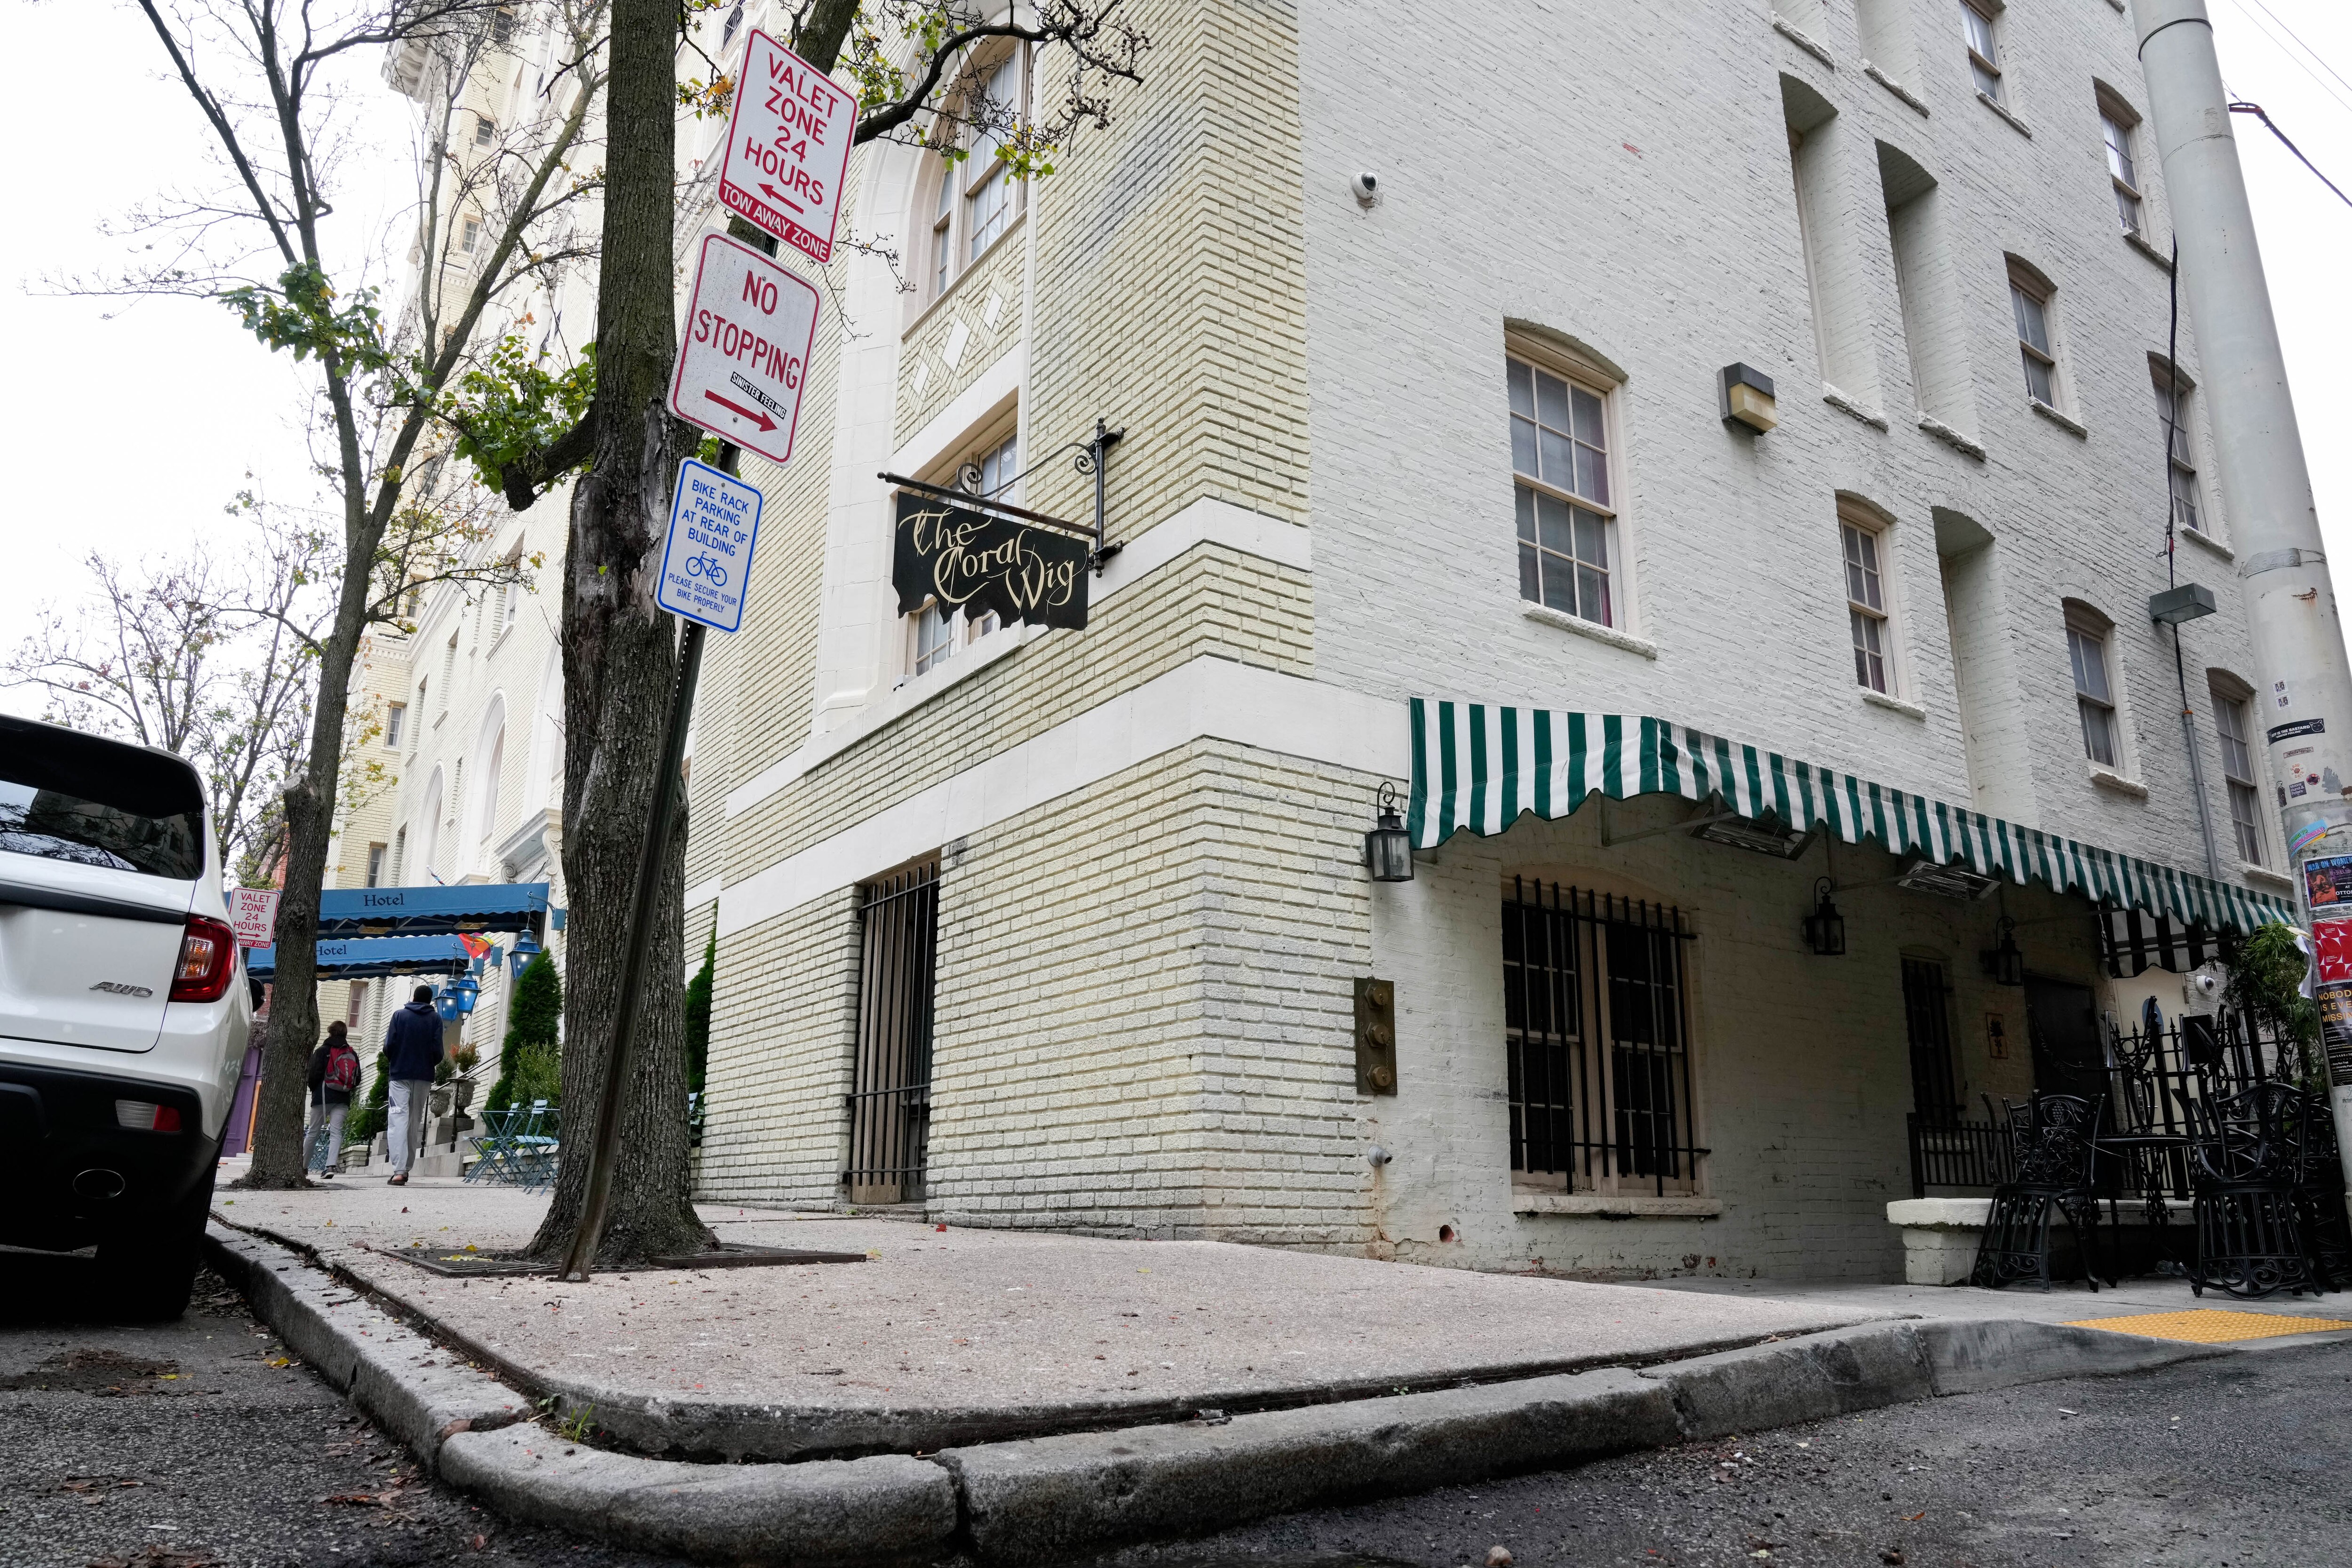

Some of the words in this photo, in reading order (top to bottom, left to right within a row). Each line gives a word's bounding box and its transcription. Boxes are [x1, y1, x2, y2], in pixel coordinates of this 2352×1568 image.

[769, 52, 838, 119] VALET
[765, 85, 827, 146] ZONE
[774, 126, 806, 163] 24
[745, 136, 824, 206] HOURS
[723, 183, 754, 215] TOW
[753, 207, 791, 237] AWAY
[791, 226, 828, 261] ZONE
[742, 270, 778, 315] NO
[695, 309, 800, 390] STOPPING
[731, 373, 761, 399] SINISTER
[760, 395, 786, 418] FEELING
[692, 479, 716, 500] BIKE
[721, 492, 749, 514] RACK
[695, 497, 740, 526] PARKING
[682, 509, 697, 523] AT
[700, 516, 729, 538] REAR
[734, 530, 748, 544] OF
[688, 527, 736, 557] BUILDING
[898, 507, 992, 557] The
[934, 529, 1032, 606] Coral
[986, 544, 1088, 615] Wig
[668, 573, 692, 589] PLEASE
[694, 583, 719, 599] SECURE
[721, 594, 737, 606] YOUR
[677, 589, 691, 601] BIKE
[694, 595, 725, 613] PROPERLY
[2307, 862, 2320, 871] WAR
[2330, 856, 2352, 867] WOMEN
[240, 902, 267, 913] ZONE
[241, 892, 271, 903] VALET
[364, 893, 405, 907] Hotel
[234, 921, 267, 932] HOURS
[245, 913, 259, 921] 24
[89, 981, 153, 997] AWD
[2330, 1001, 2352, 1010] EVE
